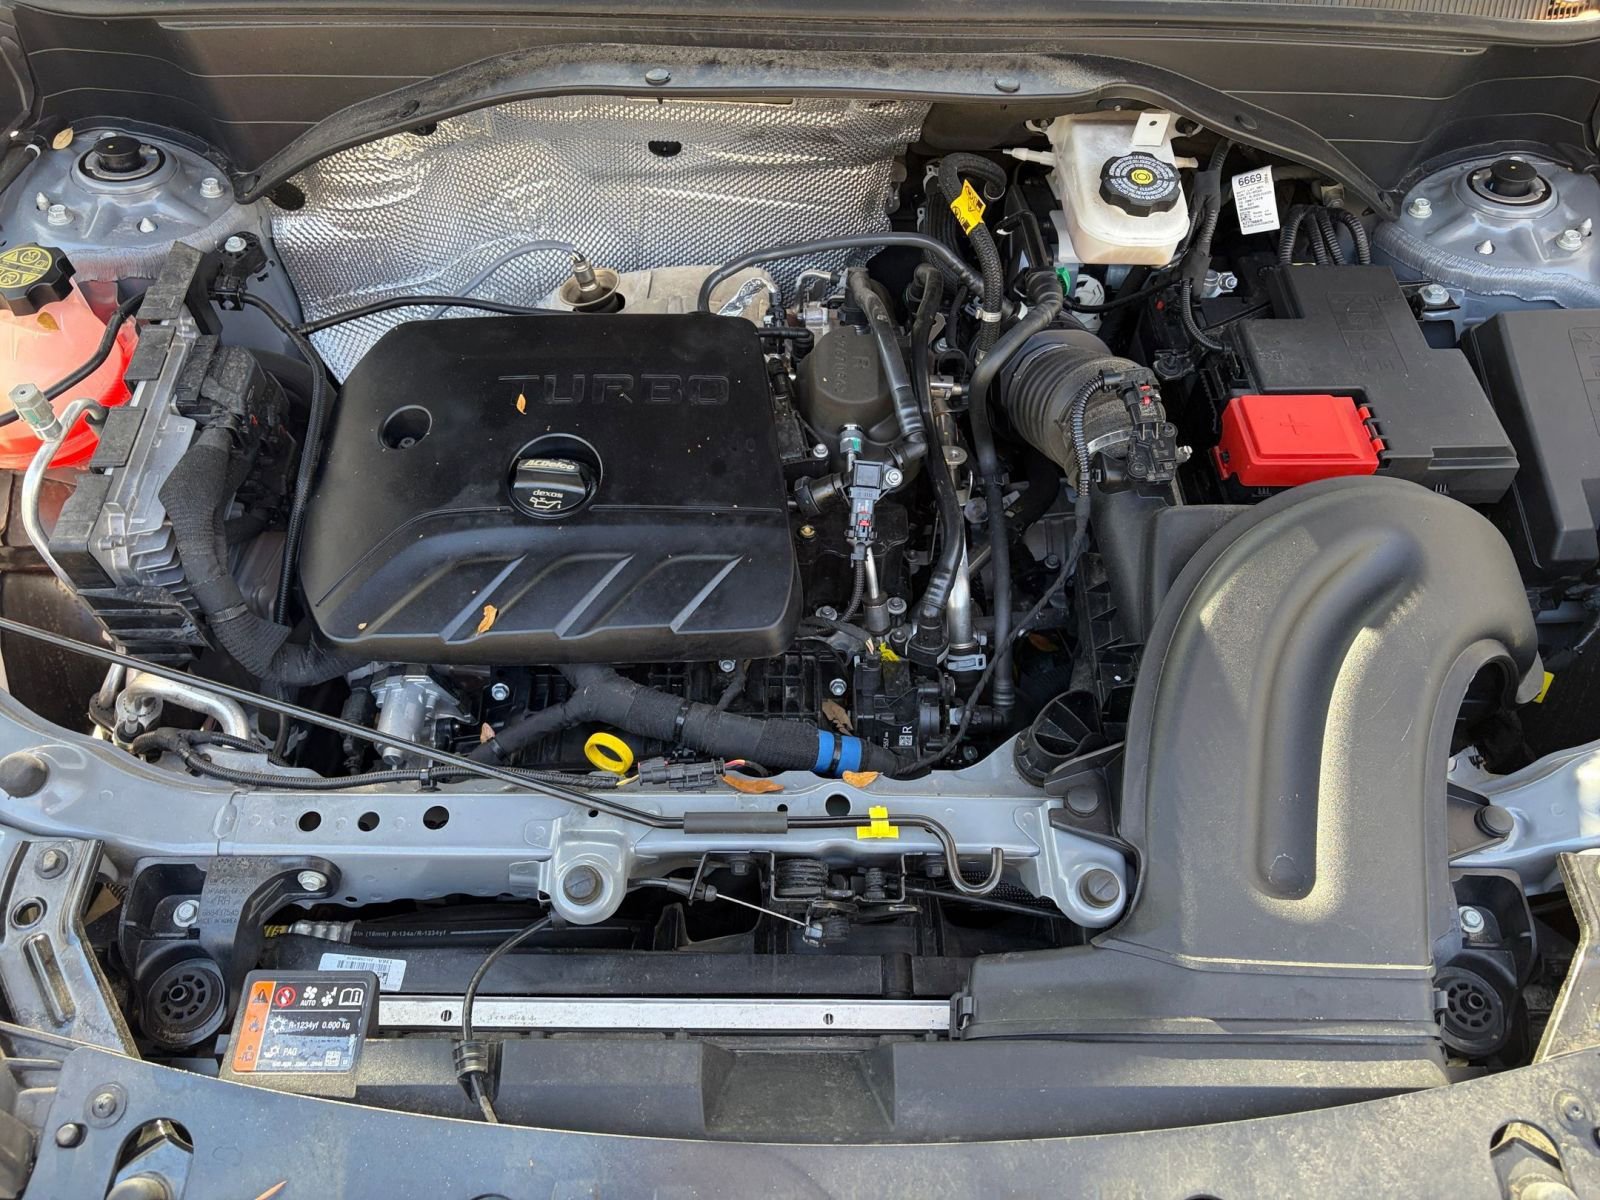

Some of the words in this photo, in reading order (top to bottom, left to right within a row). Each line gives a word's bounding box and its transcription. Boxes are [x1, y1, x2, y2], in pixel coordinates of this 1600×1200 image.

[1238, 173, 1262, 186] 6669
[498, 374, 730, 406] TURBO
[524, 458, 576, 471] ACDelco
[532, 489, 564, 499] dexos
[288, 1021, 319, 1030] R-1234yf
[341, 1020, 351, 1030] kg
[283, 1048, 297, 1056] PAG
